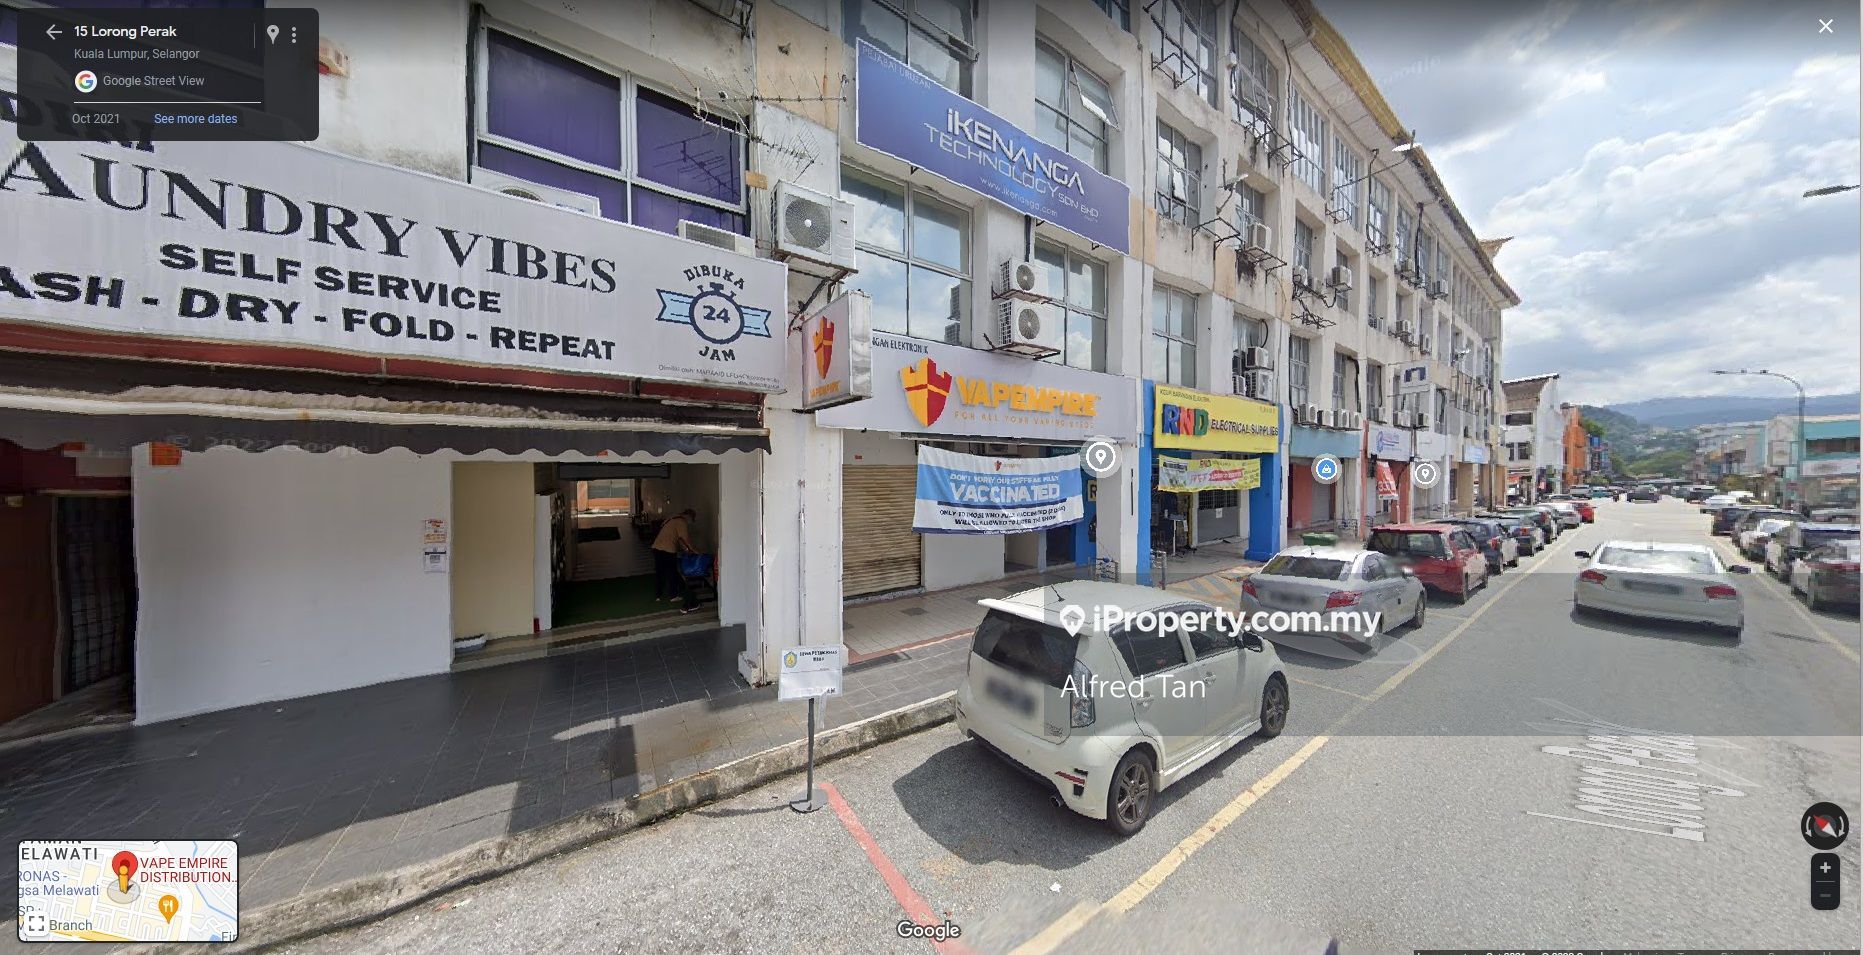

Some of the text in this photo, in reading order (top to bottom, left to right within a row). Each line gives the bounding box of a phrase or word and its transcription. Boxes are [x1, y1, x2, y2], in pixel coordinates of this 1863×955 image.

[899, 67, 931, 89] URUSAN
[947, 107, 1085, 196] iKENANGA
[923, 122, 1099, 218] TECHNOLOGY SDN BHD
[0, 141, 617, 294] AUNDRY VIBES
[159, 243, 502, 314] SELF SERVICE
[683, 264, 745, 290] DIBUKA
[141, 296, 159, 306] -
[178, 286, 301, 325] DRY
[314, 314, 328, 323] -
[342, 306, 455, 343] FOLD
[466, 332, 479, 341] -
[490, 325, 616, 361] REPEAT
[703, 304, 731, 324] 24
[699, 346, 736, 361] JAM
[955, 375, 1098, 418] VAPEMPIRE
[954, 411, 976, 421] FOR
[981, 412, 998, 422] ALL
[1005, 415, 1029, 425] YOUR
[1162, 403, 1209, 437] RND
[1210, 418, 1279, 437] ELECTRICAL SUPPLIES
[950, 482, 1061, 503] VACCINATED
